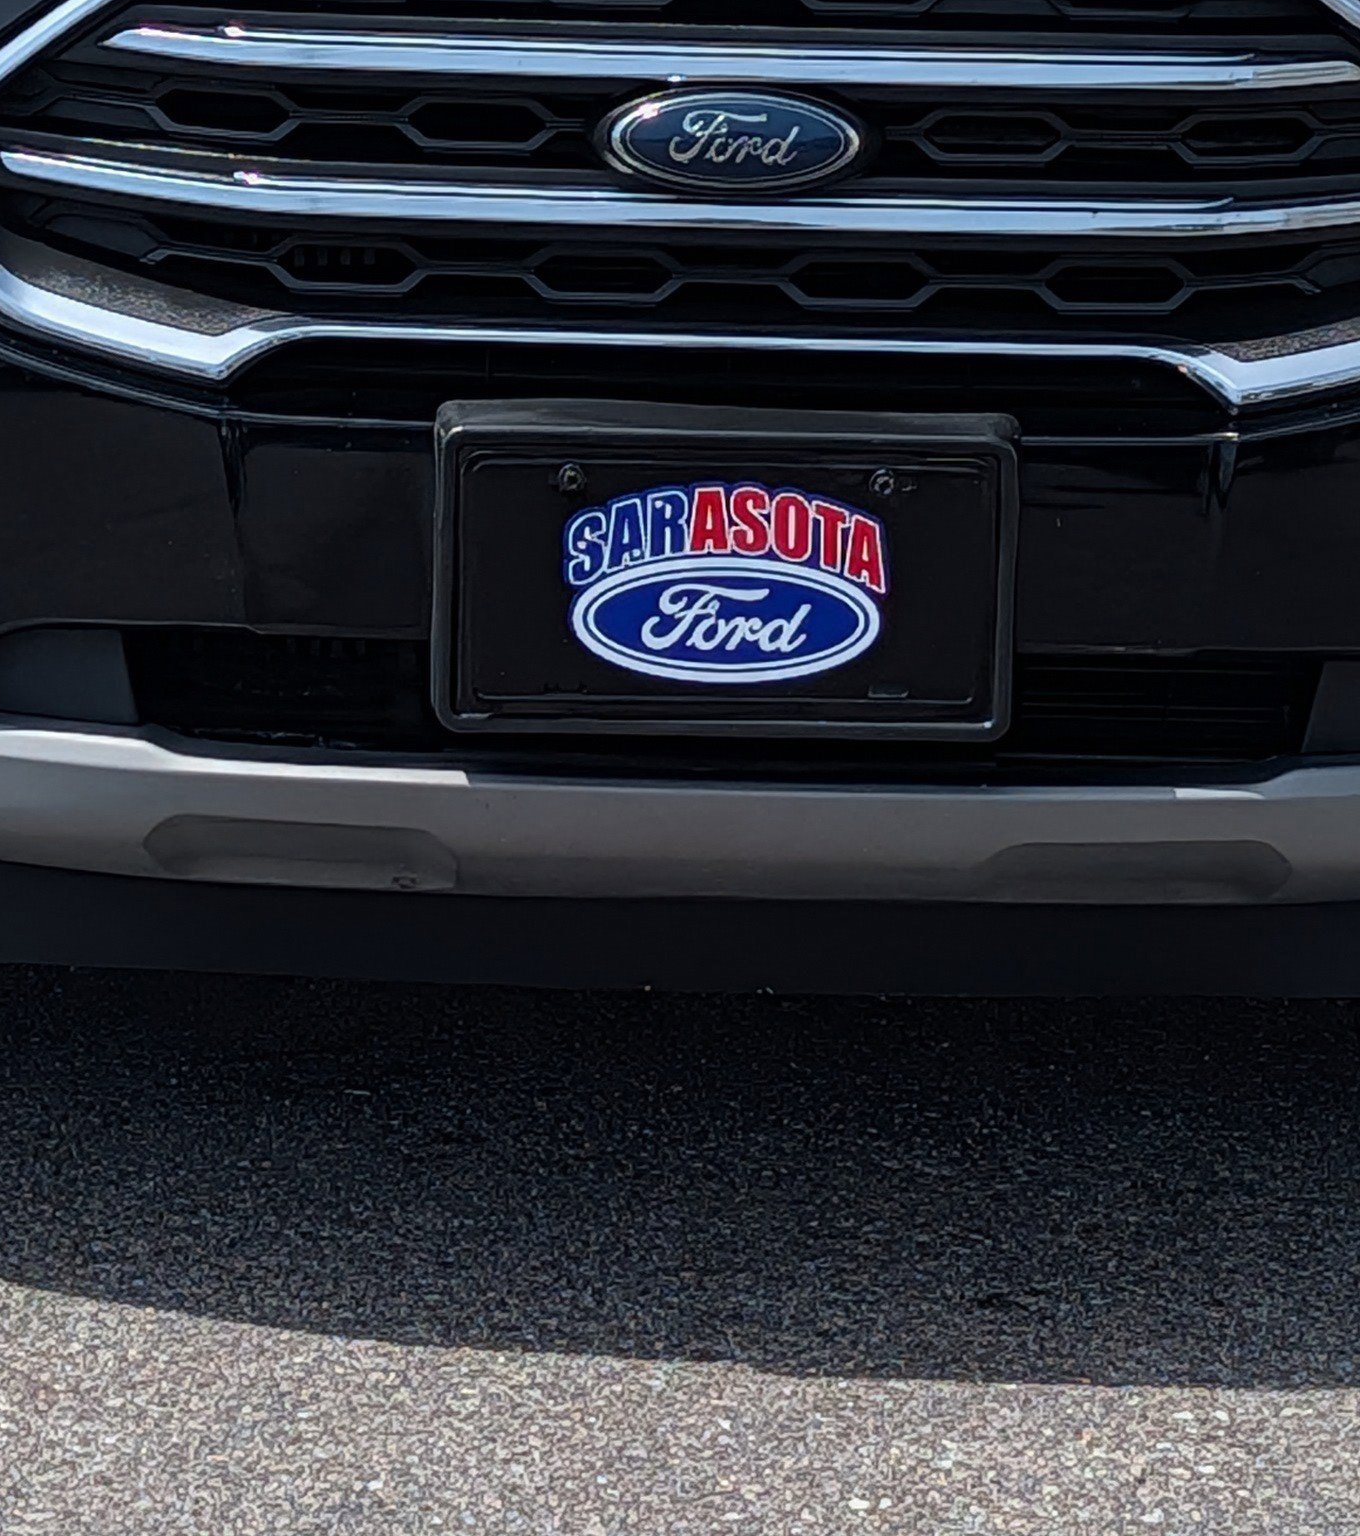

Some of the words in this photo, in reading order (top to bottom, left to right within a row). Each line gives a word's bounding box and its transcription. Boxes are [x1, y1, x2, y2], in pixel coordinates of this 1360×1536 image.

[668, 109, 801, 166] Ford
[567, 486, 887, 595] SARASOTA
[641, 583, 812, 653] Ford
